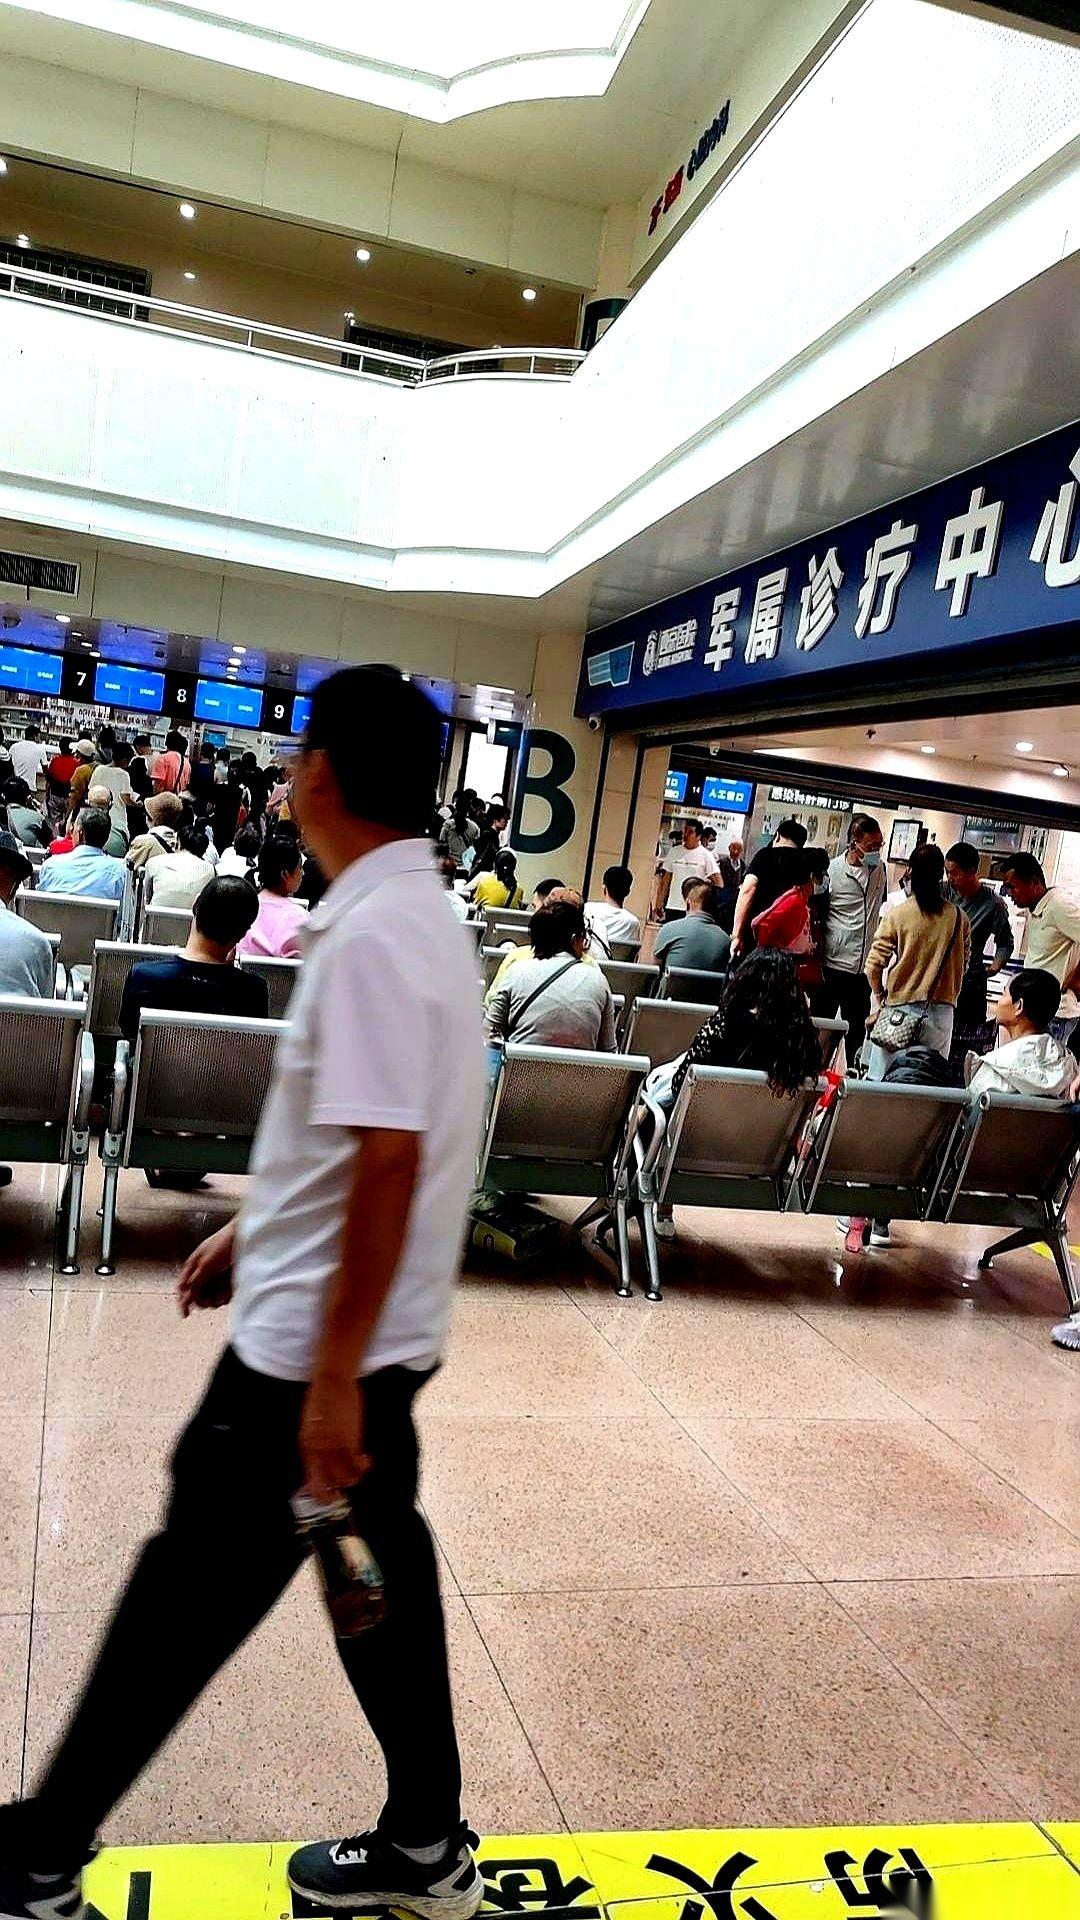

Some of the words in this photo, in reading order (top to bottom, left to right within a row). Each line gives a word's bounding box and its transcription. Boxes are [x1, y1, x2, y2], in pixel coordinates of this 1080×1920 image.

[704, 447, 1080, 671] 军属诊疗中心
[77, 672, 86, 686] 7
[177, 689, 186, 702] 8
[274, 705, 284, 718] 9
[509, 729, 576, 853] B
